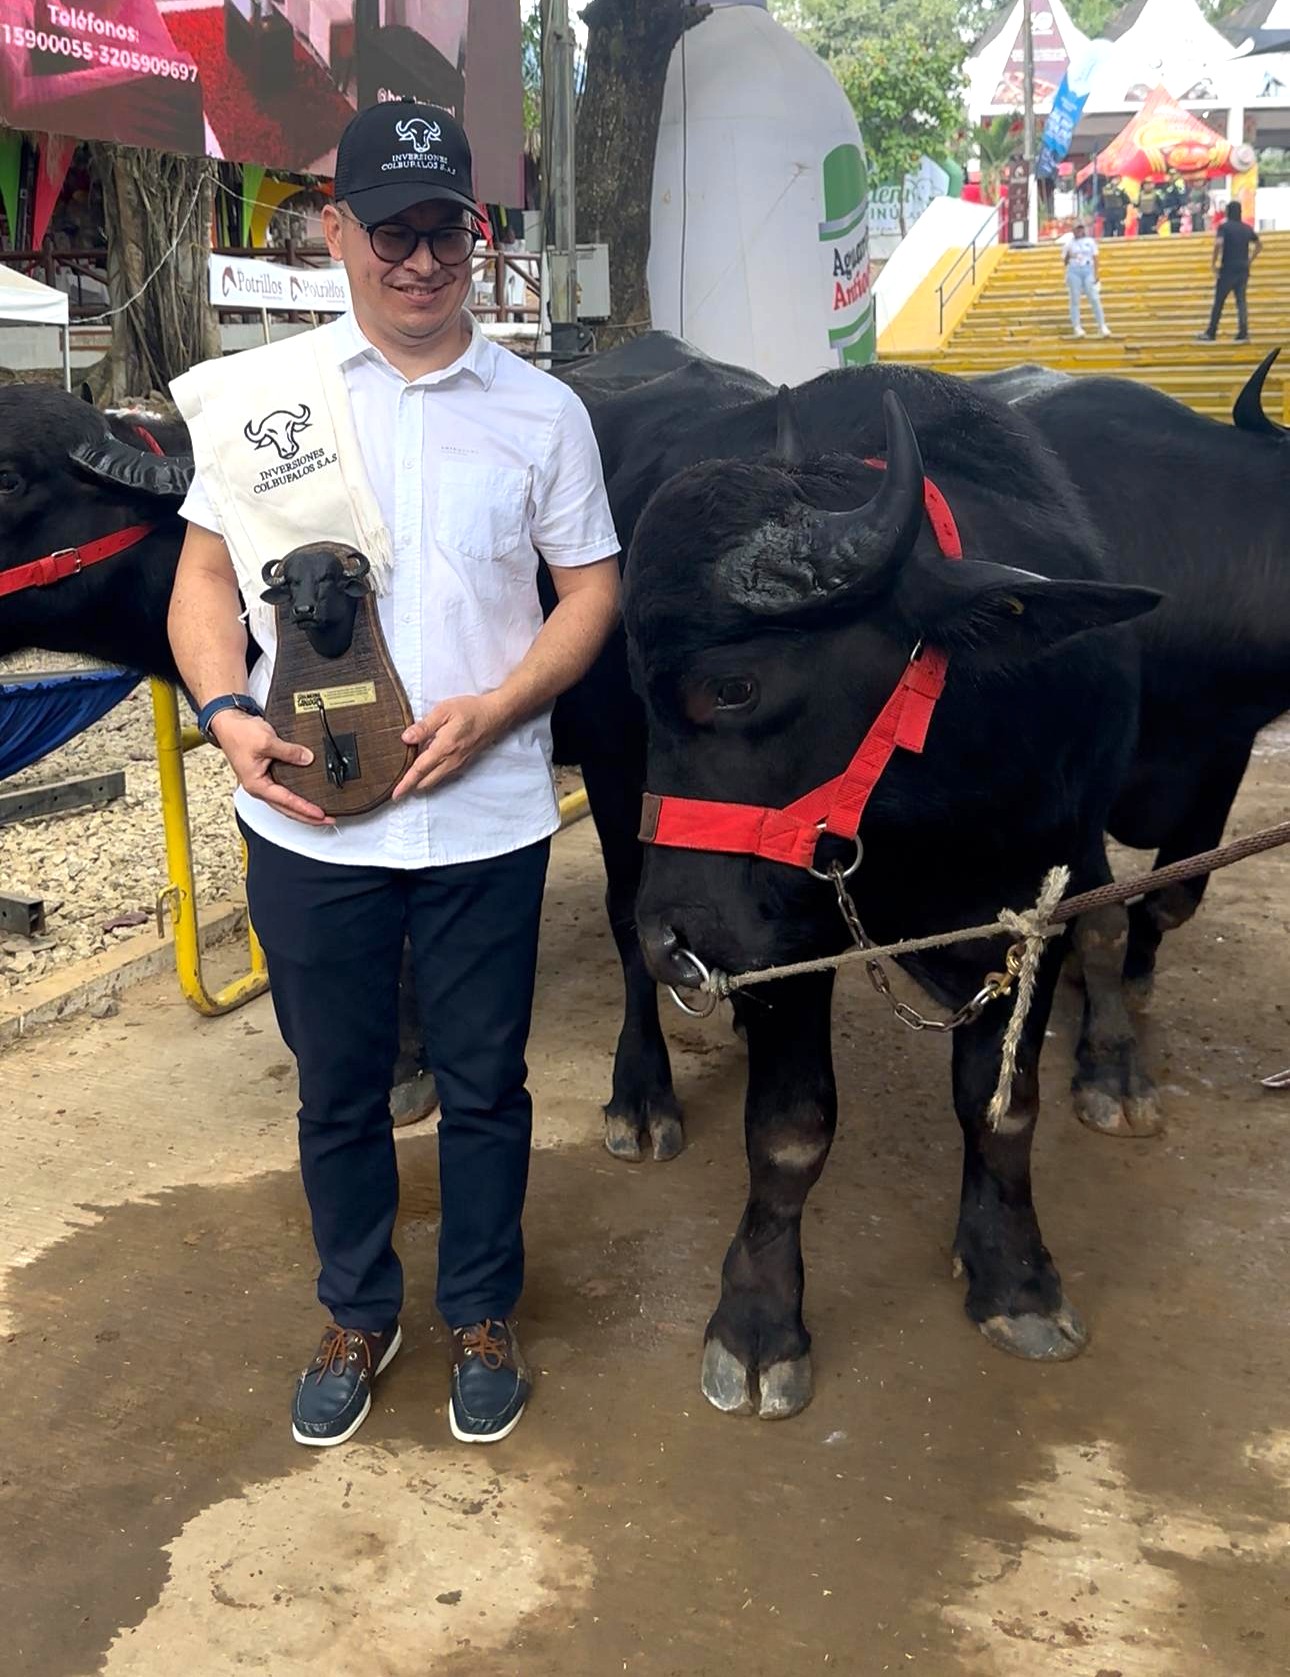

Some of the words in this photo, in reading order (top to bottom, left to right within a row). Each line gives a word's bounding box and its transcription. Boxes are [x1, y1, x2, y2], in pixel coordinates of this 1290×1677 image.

[381, 161, 438, 171] COLBUFALOS
[392, 153, 448, 163] INVERSIONES
[237, 268, 283, 295] Potrillos
[303, 279, 346, 298] Potrillos
[259, 447, 325, 481] INVERSIONES
[253, 463, 316, 494] COLBUFALOS
